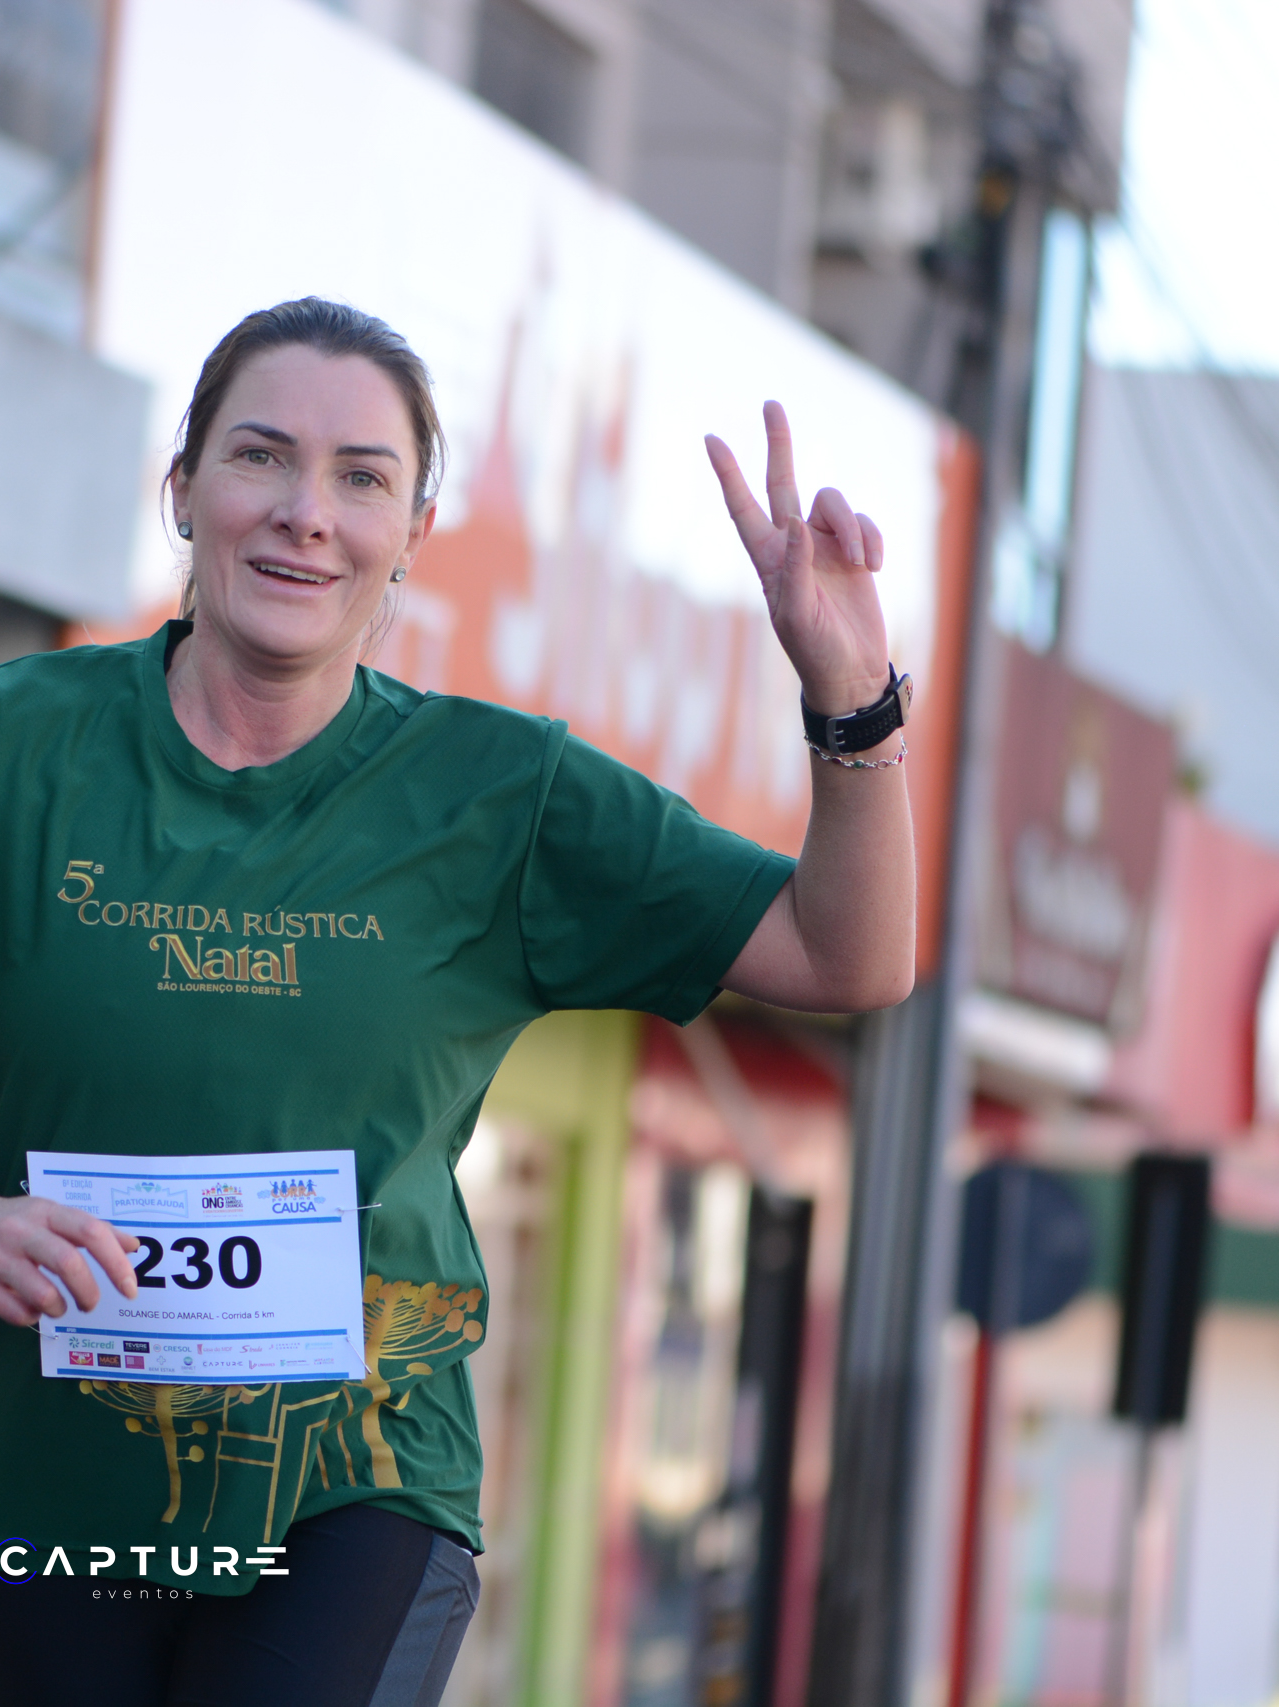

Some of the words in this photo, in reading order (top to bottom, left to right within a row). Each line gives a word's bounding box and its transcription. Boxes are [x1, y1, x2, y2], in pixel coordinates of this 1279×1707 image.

[78, 900, 233, 933] CORRIDA
[243, 905, 384, 940] RÚSTICA
[149, 933, 299, 985] Natal
[157, 981, 178, 992] SÃO
[179, 982, 233, 994] LOURENÇO
[235, 984, 249, 993] DO
[251, 985, 281, 996] OESTE
[289, 987, 301, 997] SC
[71, 1179, 93, 1190] EDIÇÃO
[65, 1192, 92, 1201] CORRIDA
[201, 1196, 224, 1209] ONG
[115, 1198, 156, 1208] PRATIQUE
[156, 1199, 185, 1209] AJUDA
[272, 1201, 317, 1214] CAUSA
[133, 1236, 262, 1289] 230
[118, 1309, 160, 1319] SOLANGE
[162, 1311, 175, 1319] DO
[177, 1311, 214, 1320] AMARAL
[222, 1311, 252, 1320] Corrida
[254, 1310, 260, 1319] 5
[262, 1310, 275, 1319] km
[81, 1339, 115, 1350] Sicredi
